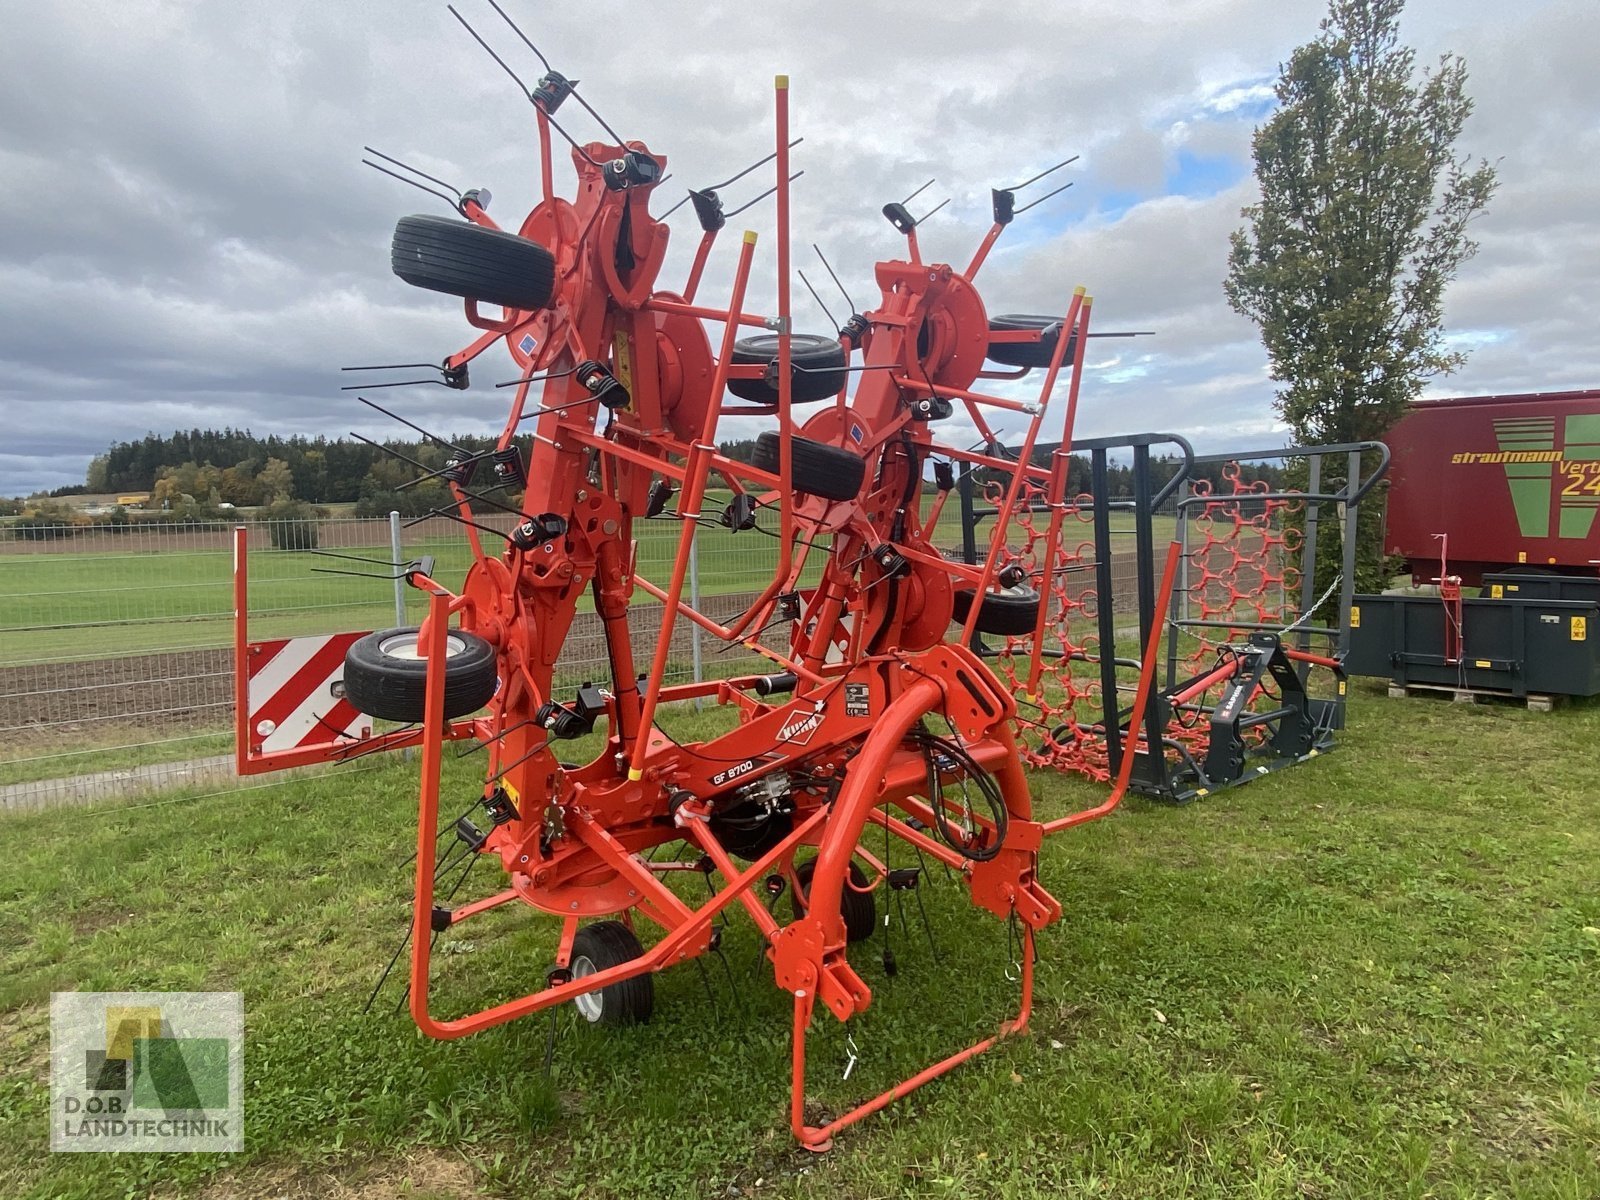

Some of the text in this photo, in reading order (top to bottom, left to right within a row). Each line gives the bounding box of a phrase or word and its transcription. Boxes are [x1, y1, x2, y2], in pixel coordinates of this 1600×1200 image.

[1451, 451, 1563, 464] strautmann
[783, 715, 818, 740] KUHN
[713, 760, 753, 785] GF 8700
